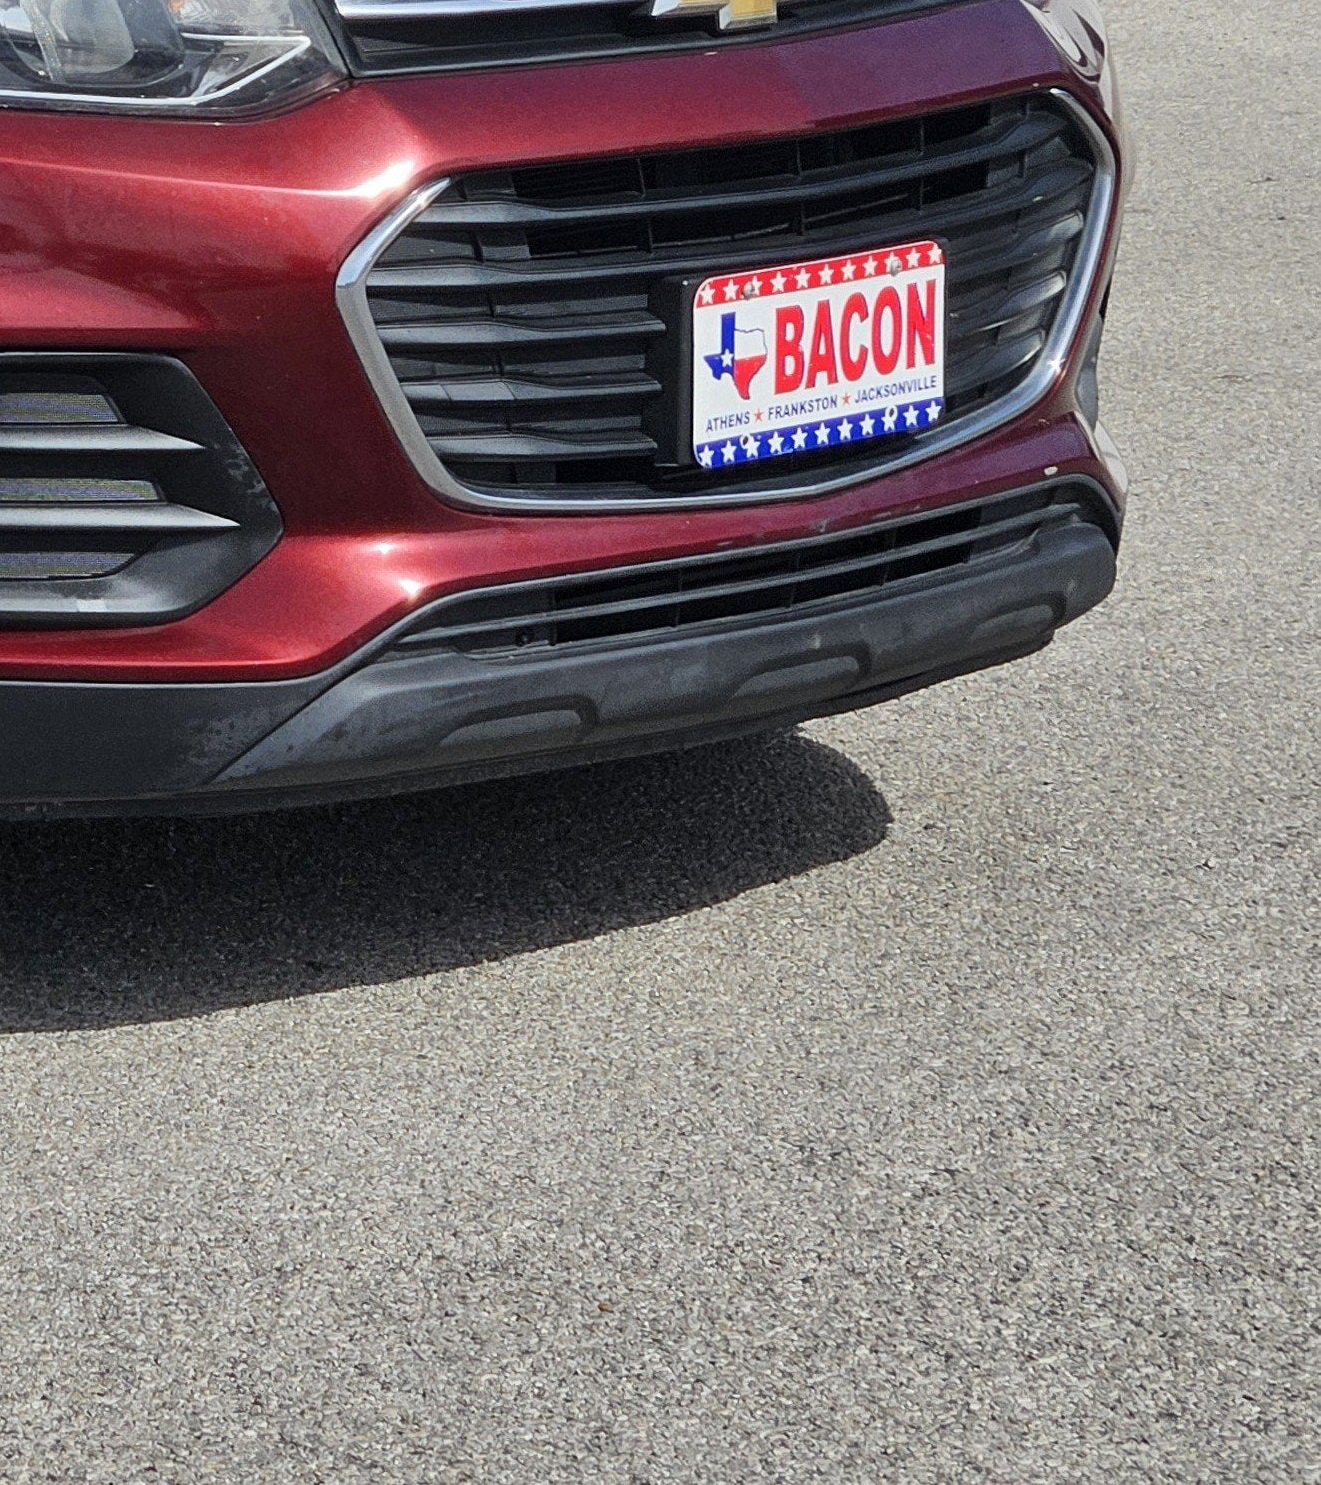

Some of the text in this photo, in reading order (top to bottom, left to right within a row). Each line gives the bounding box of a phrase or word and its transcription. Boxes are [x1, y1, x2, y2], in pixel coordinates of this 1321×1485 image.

[774, 279, 936, 395] BACON
[706, 375, 937, 432] ATHENS FRANKSTON JACKSONVILLE
